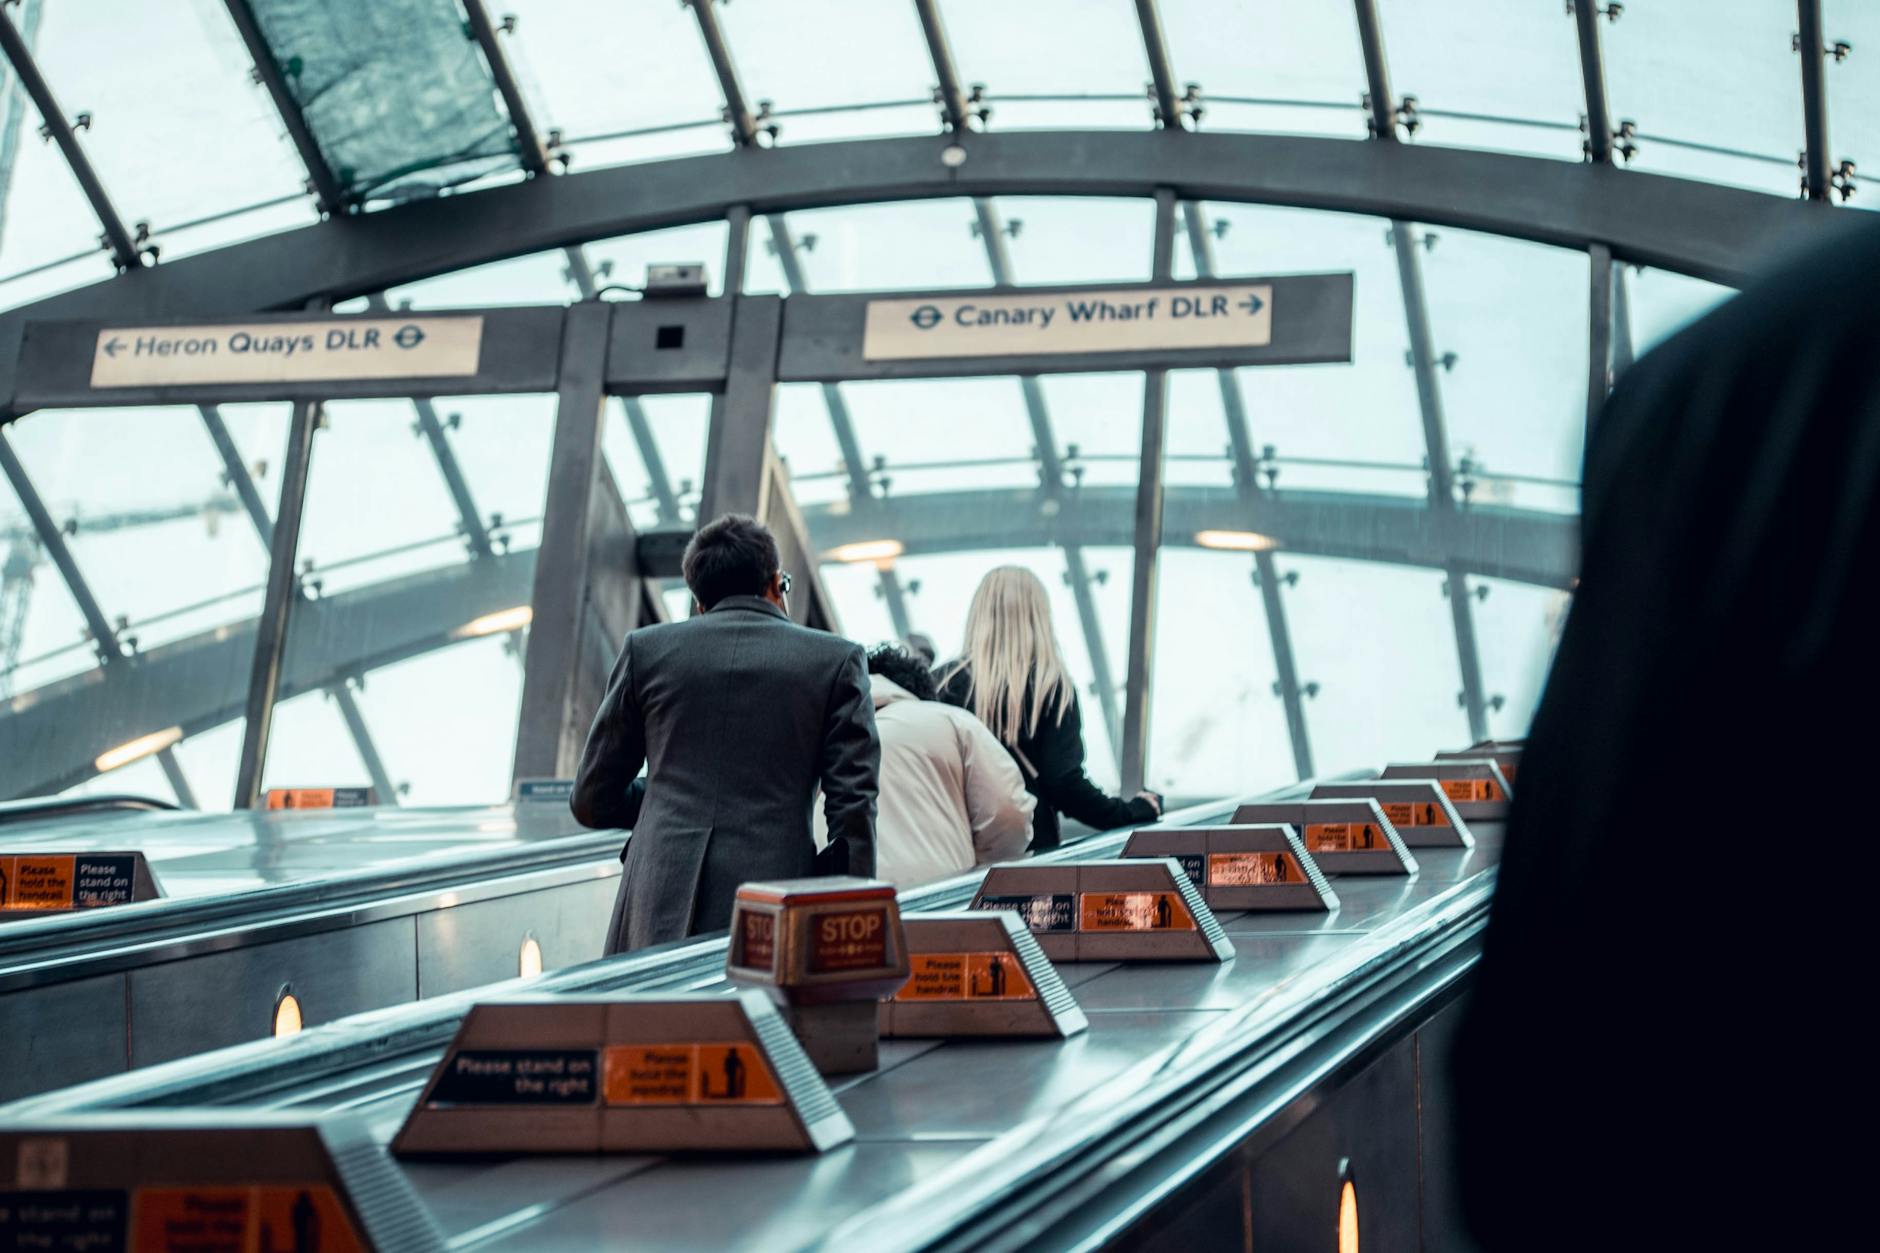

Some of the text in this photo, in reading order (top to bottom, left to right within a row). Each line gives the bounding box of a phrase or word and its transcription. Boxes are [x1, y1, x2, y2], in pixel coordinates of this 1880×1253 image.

[954, 294, 1230, 328] Canary Wharf DLR
[134, 328, 381, 359] Heron Quays DLR
[21, 865, 56, 875] Please
[80, 864, 117, 875] Please
[20, 877, 66, 888] hold the
[80, 877, 128, 888] stand on
[79, 889, 127, 902] the right
[982, 901, 1019, 911] Please
[1055, 901, 1070, 910] on
[747, 914, 774, 940] STO
[822, 914, 880, 942] STOP
[926, 960, 961, 969] Please
[915, 972, 940, 982] hold
[915, 984, 961, 994] handrail
[456, 1057, 591, 1075] Please stand on
[514, 1077, 590, 1097] the right
